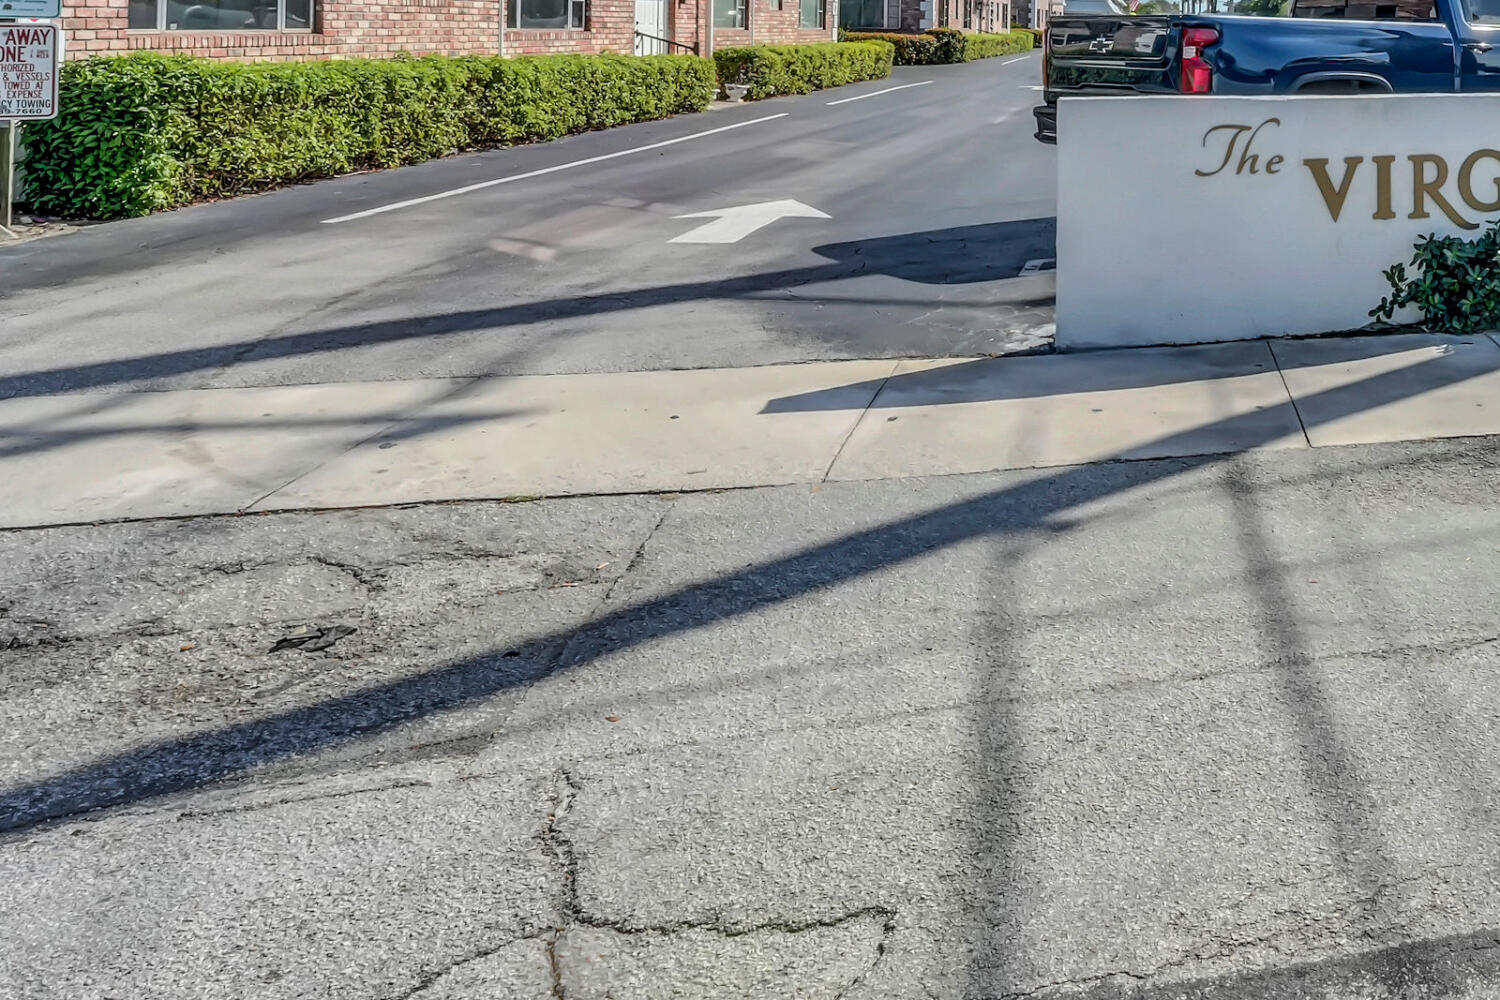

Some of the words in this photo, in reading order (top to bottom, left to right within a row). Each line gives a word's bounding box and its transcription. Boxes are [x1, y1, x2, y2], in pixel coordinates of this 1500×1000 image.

[5, 28, 51, 46] AWAY
[16, 72, 50, 81] VESSELS
[4, 81, 31, 90] TOWED
[7, 90, 43, 99] EXPENSE
[16, 99, 51, 109] TOWING
[1194, 117, 1285, 177] The
